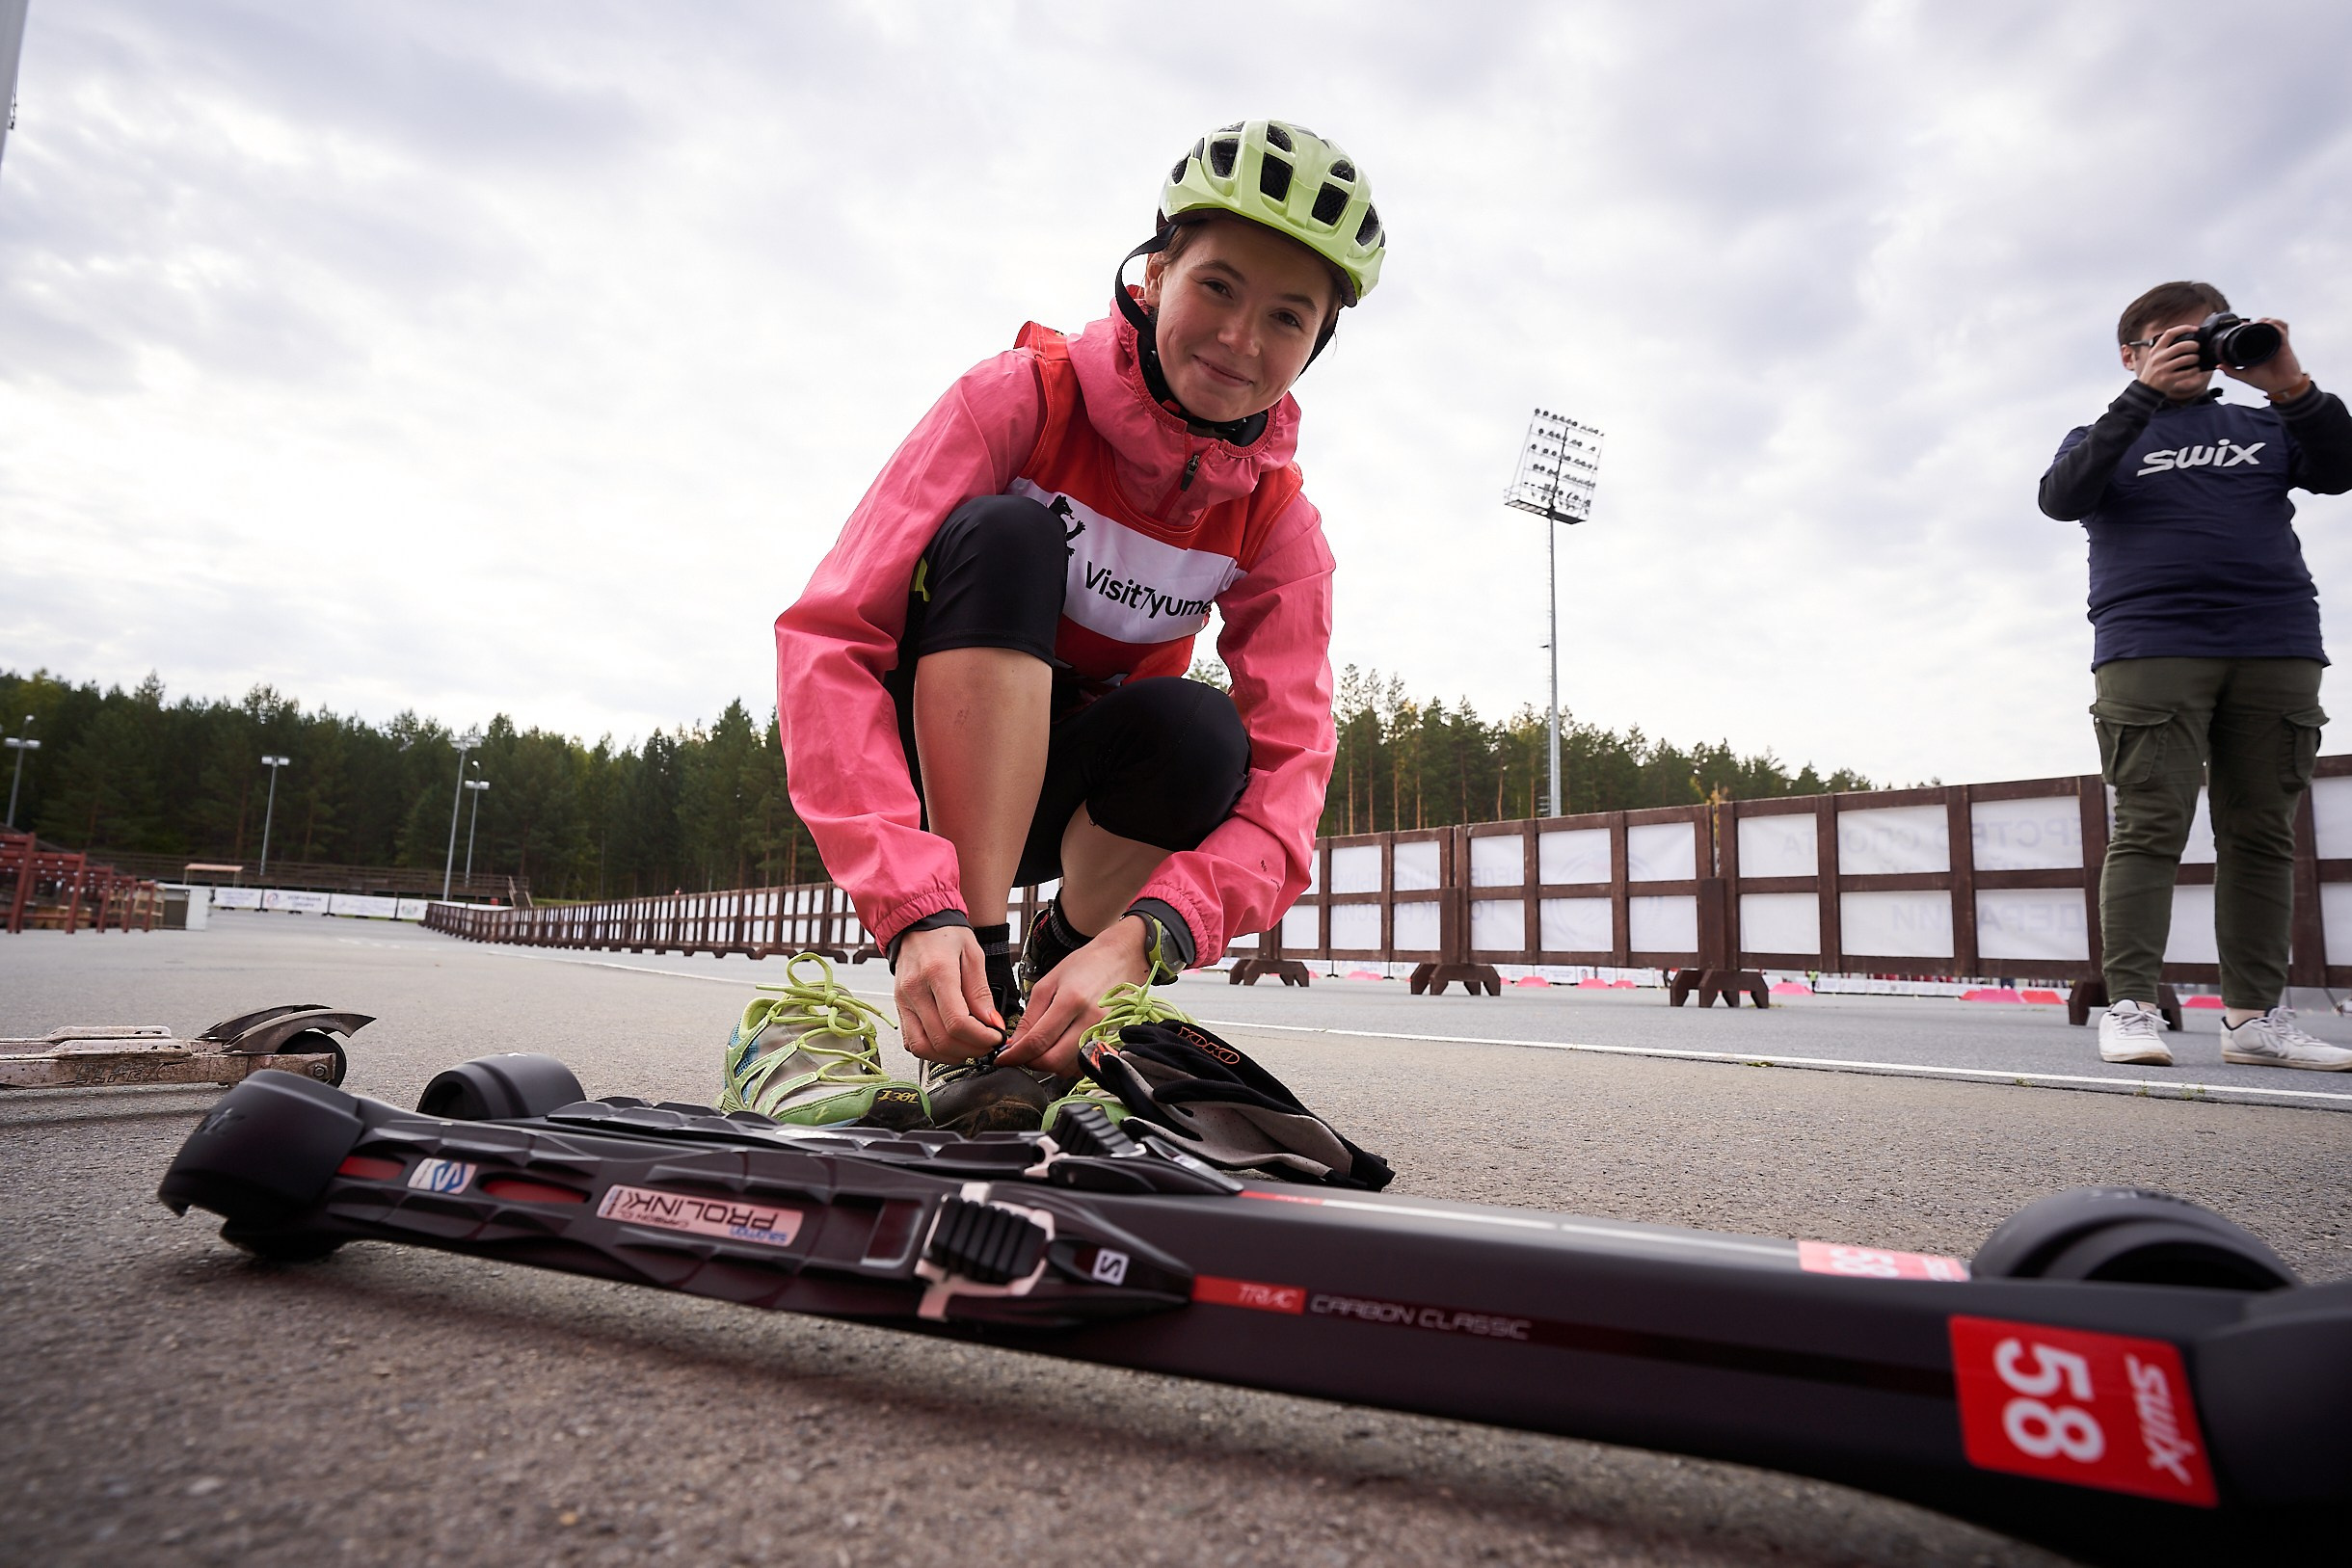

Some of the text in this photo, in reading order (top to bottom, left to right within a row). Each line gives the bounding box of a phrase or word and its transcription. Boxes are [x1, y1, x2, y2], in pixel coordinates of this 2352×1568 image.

[1084, 560, 1214, 619] VisitTyume
[624, 1191, 778, 1230] PROLINK
[1993, 1337, 2106, 1464] 58
